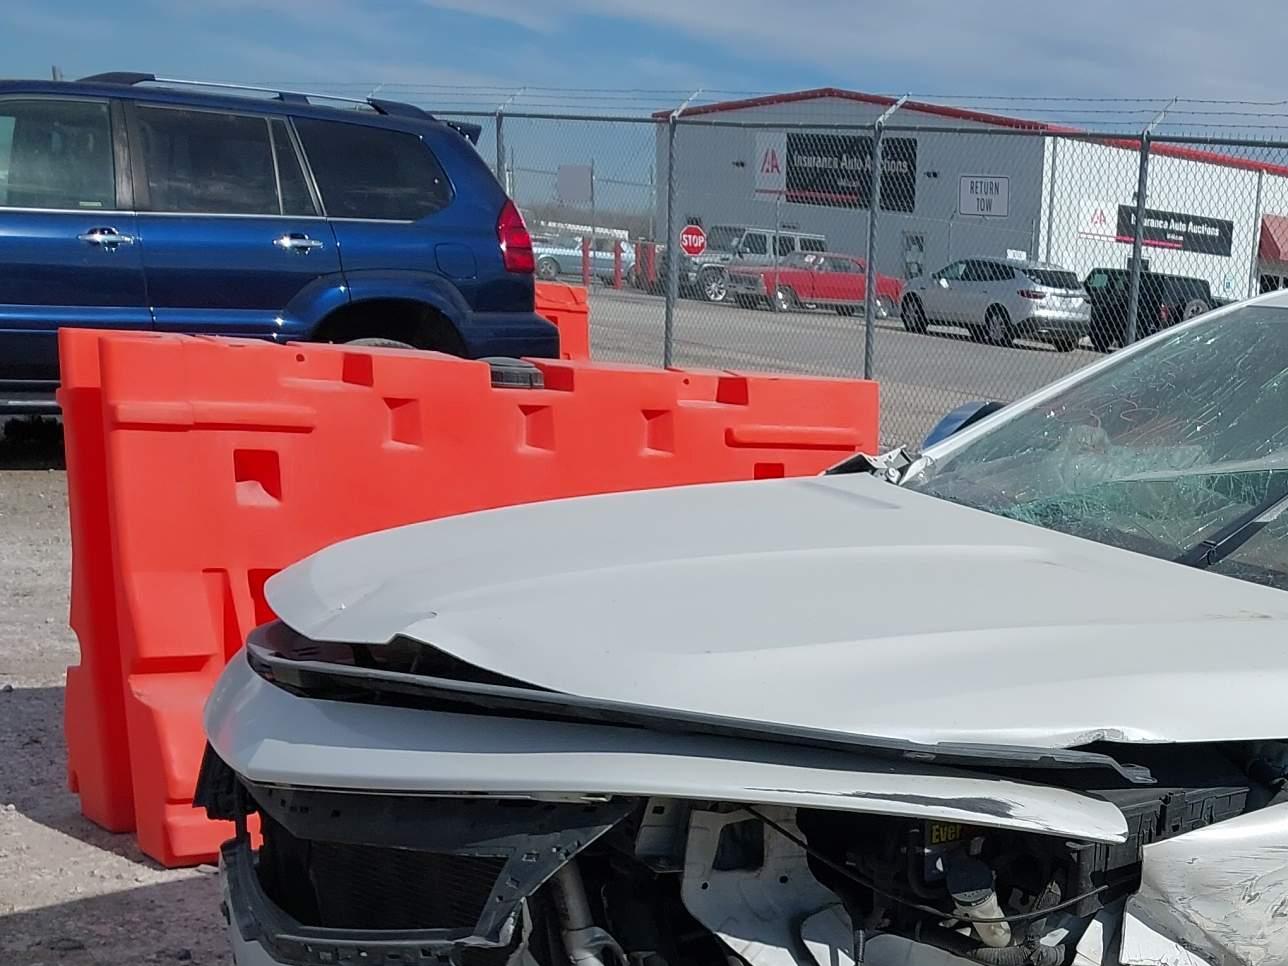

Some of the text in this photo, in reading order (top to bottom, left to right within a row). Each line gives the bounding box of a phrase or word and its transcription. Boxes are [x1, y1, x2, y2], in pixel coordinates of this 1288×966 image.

[970, 180, 999, 195] RETURN
[976, 198, 992, 212] TOW
[1169, 219, 1186, 232] Auto
[1187, 221, 1220, 236] Auctions
[682, 234, 705, 247] STOP
